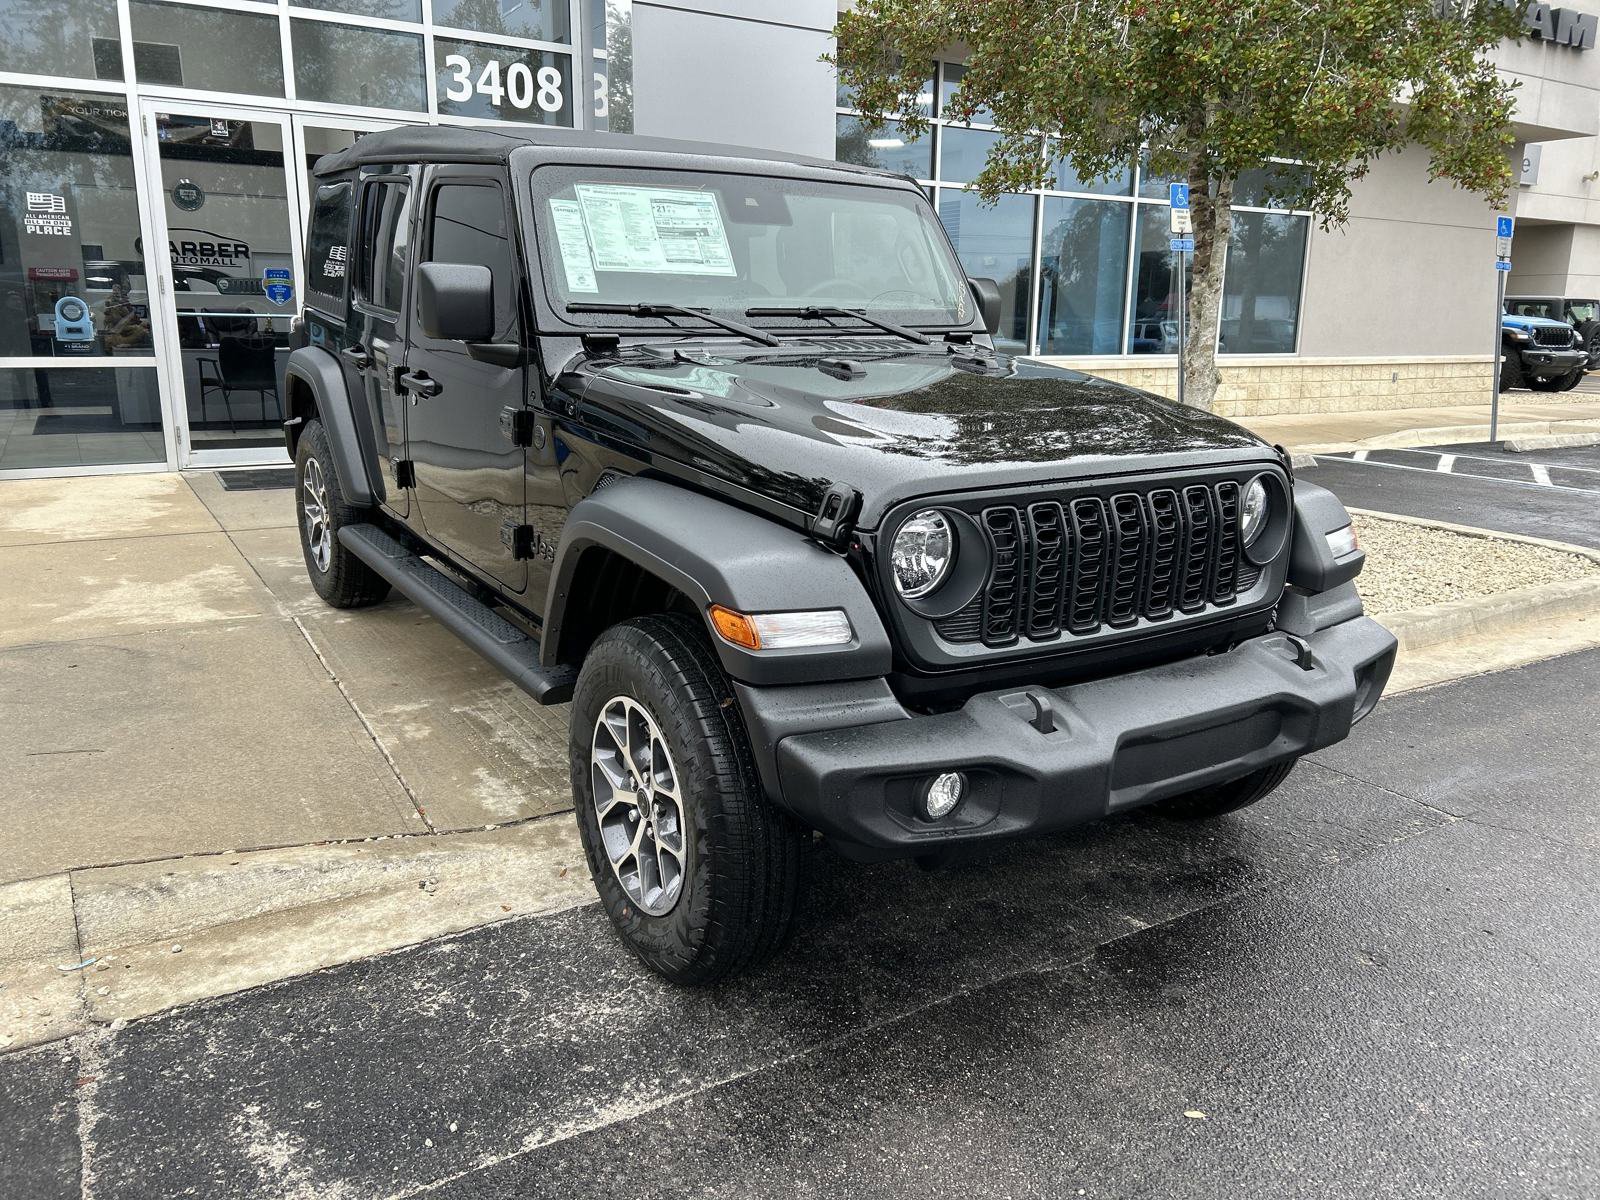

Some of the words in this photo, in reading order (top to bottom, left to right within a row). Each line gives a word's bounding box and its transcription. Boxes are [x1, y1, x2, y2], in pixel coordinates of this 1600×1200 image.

[1502, 0, 1600, 50] AM
[446, 54, 564, 113] 3408
[69, 106, 102, 117] YOUR
[104, 109, 128, 119] TICK
[656, 205, 666, 213] 21
[26, 225, 72, 236] PLACE
[170, 256, 237, 265] UTOMALL
[530, 535, 554, 561] Jee
